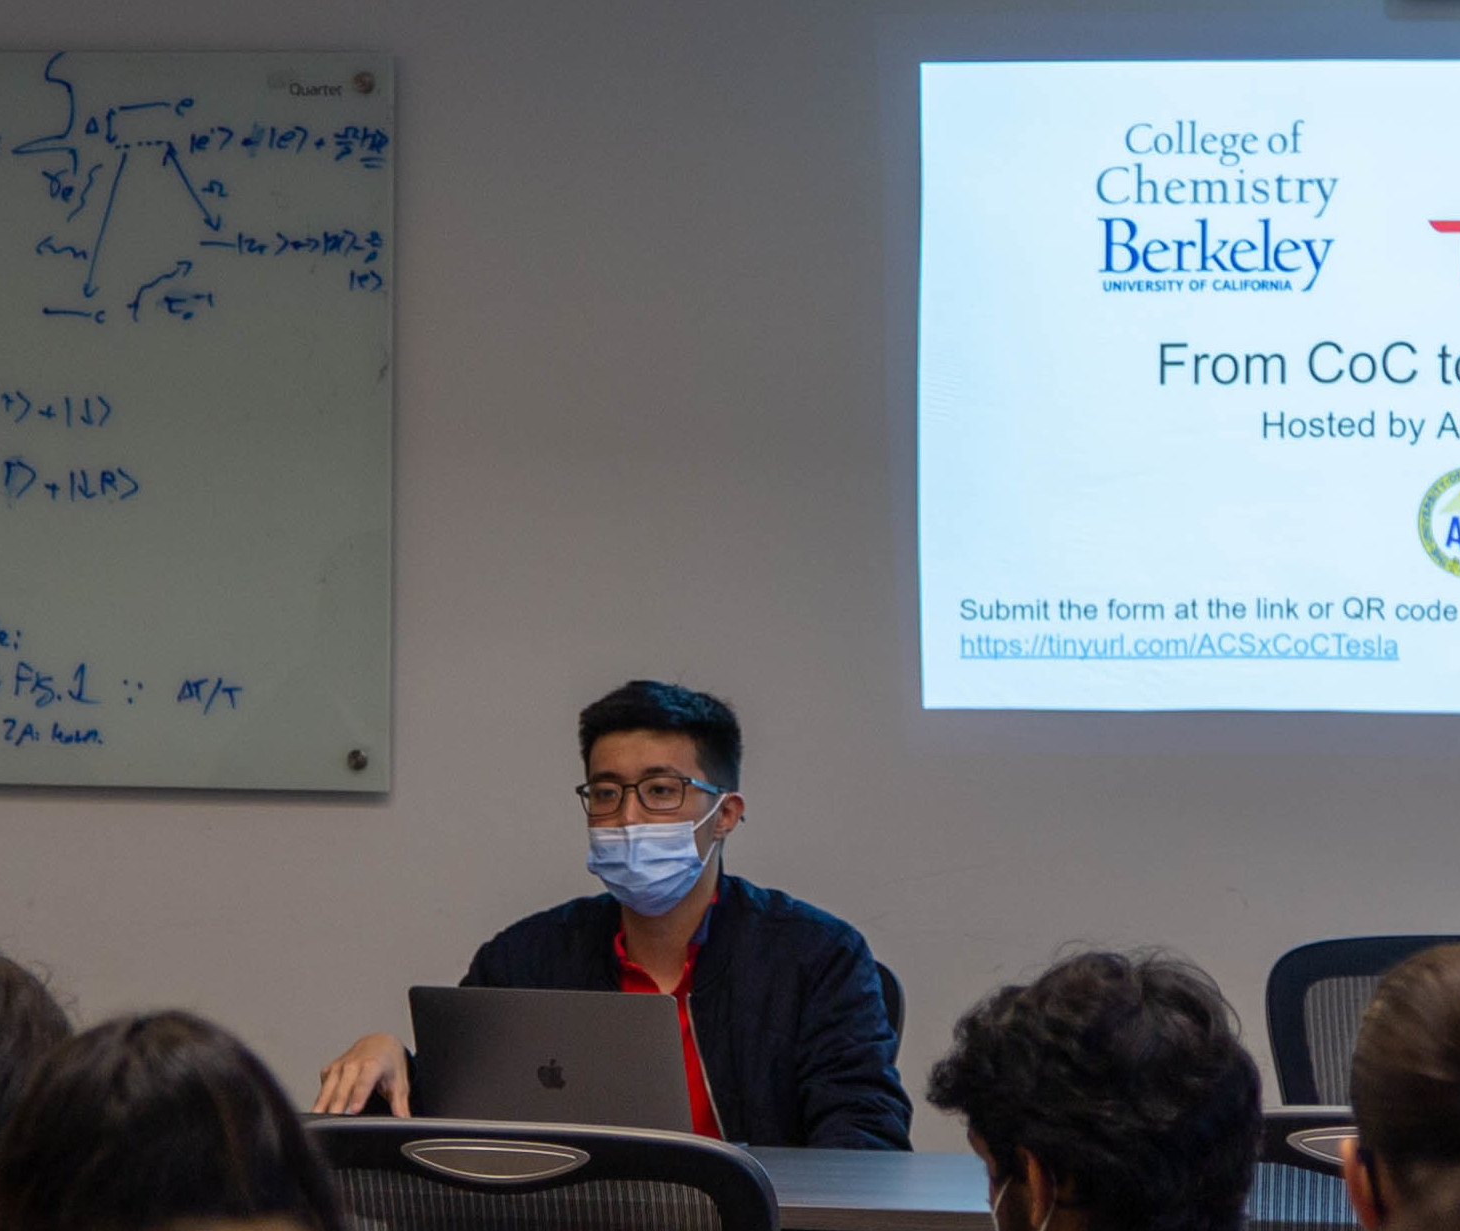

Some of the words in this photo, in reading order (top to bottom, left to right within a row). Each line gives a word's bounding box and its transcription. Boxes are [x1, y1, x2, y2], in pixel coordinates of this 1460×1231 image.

[1124, 119, 1259, 167] College
[1267, 119, 1305, 154] of
[1096, 162, 1339, 219] Chemistry
[1098, 217, 1335, 292] Berkeley
[1102, 280, 1184, 292] UNIVERSITY
[1189, 280, 1207, 291] OF
[1212, 280, 1293, 291] CALIFORNIA
[1158, 341, 1287, 387] From
[1307, 340, 1419, 386] CoC
[1262, 410, 1376, 440] Hosted
[1388, 410, 1426, 447] by
[959, 598, 1051, 622] Submit
[1057, 598, 1099, 621] the
[1106, 597, 1165, 621] form
[1173, 598, 1199, 621] at
[1206, 597, 1247, 620] the
[1255, 597, 1299, 620] link
[1307, 602, 1335, 620] or
[1341, 596, 1386, 621] QR
[1394, 598, 1458, 622] code
[960, 631, 1399, 661] https://tinyurl.com/ACSxCoCTesla
